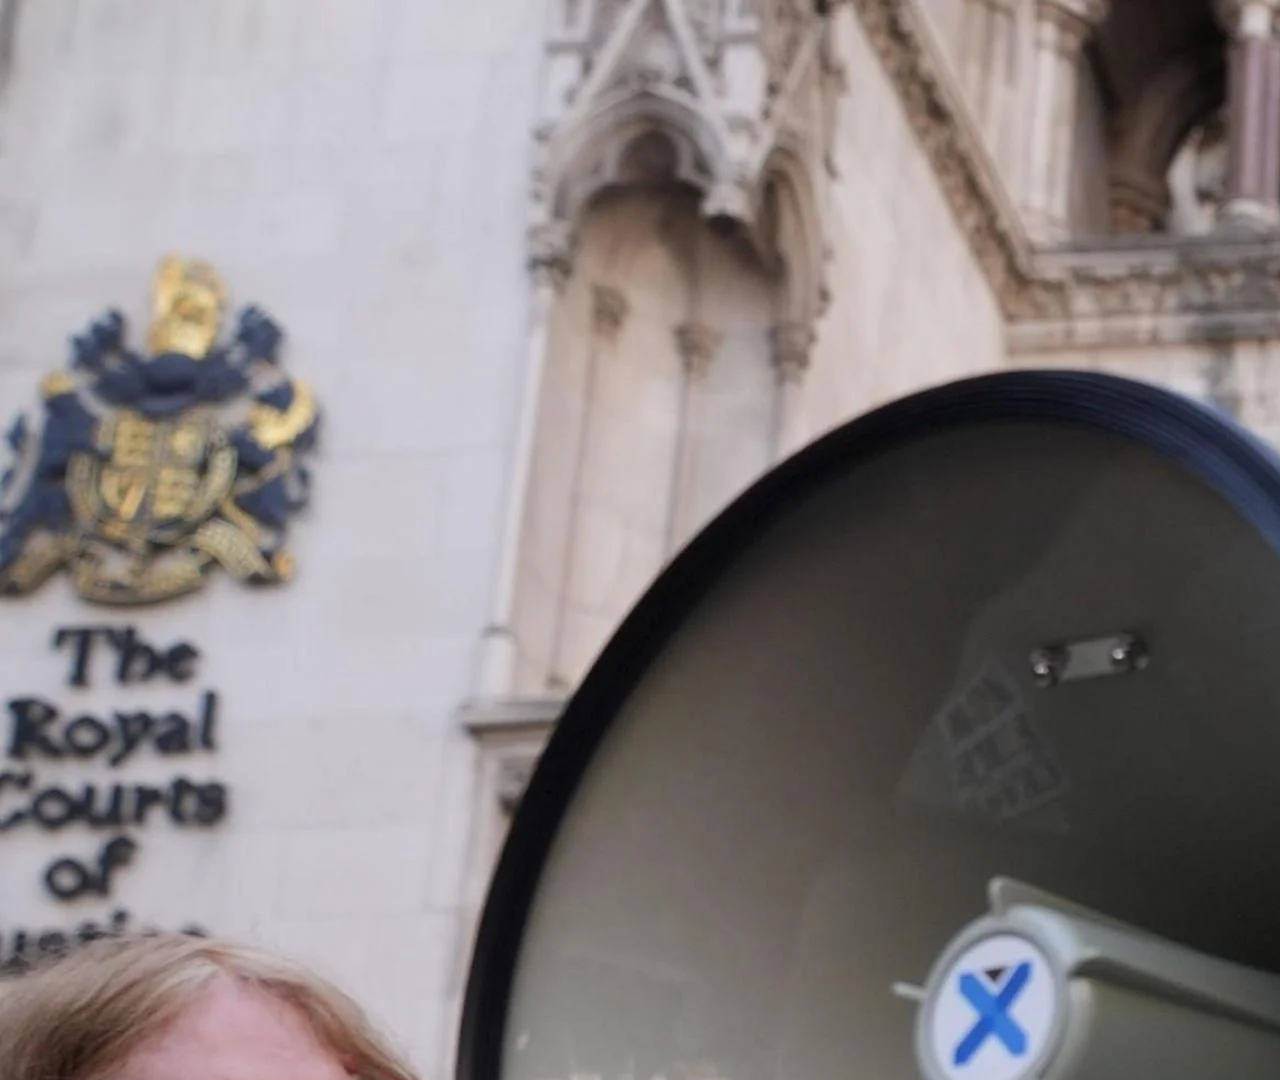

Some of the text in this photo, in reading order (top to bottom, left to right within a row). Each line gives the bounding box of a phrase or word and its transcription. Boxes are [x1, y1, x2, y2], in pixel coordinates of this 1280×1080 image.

[53, 625, 201, 687] The
[8, 690, 218, 766] Royal
[45, 835, 138, 899] of
